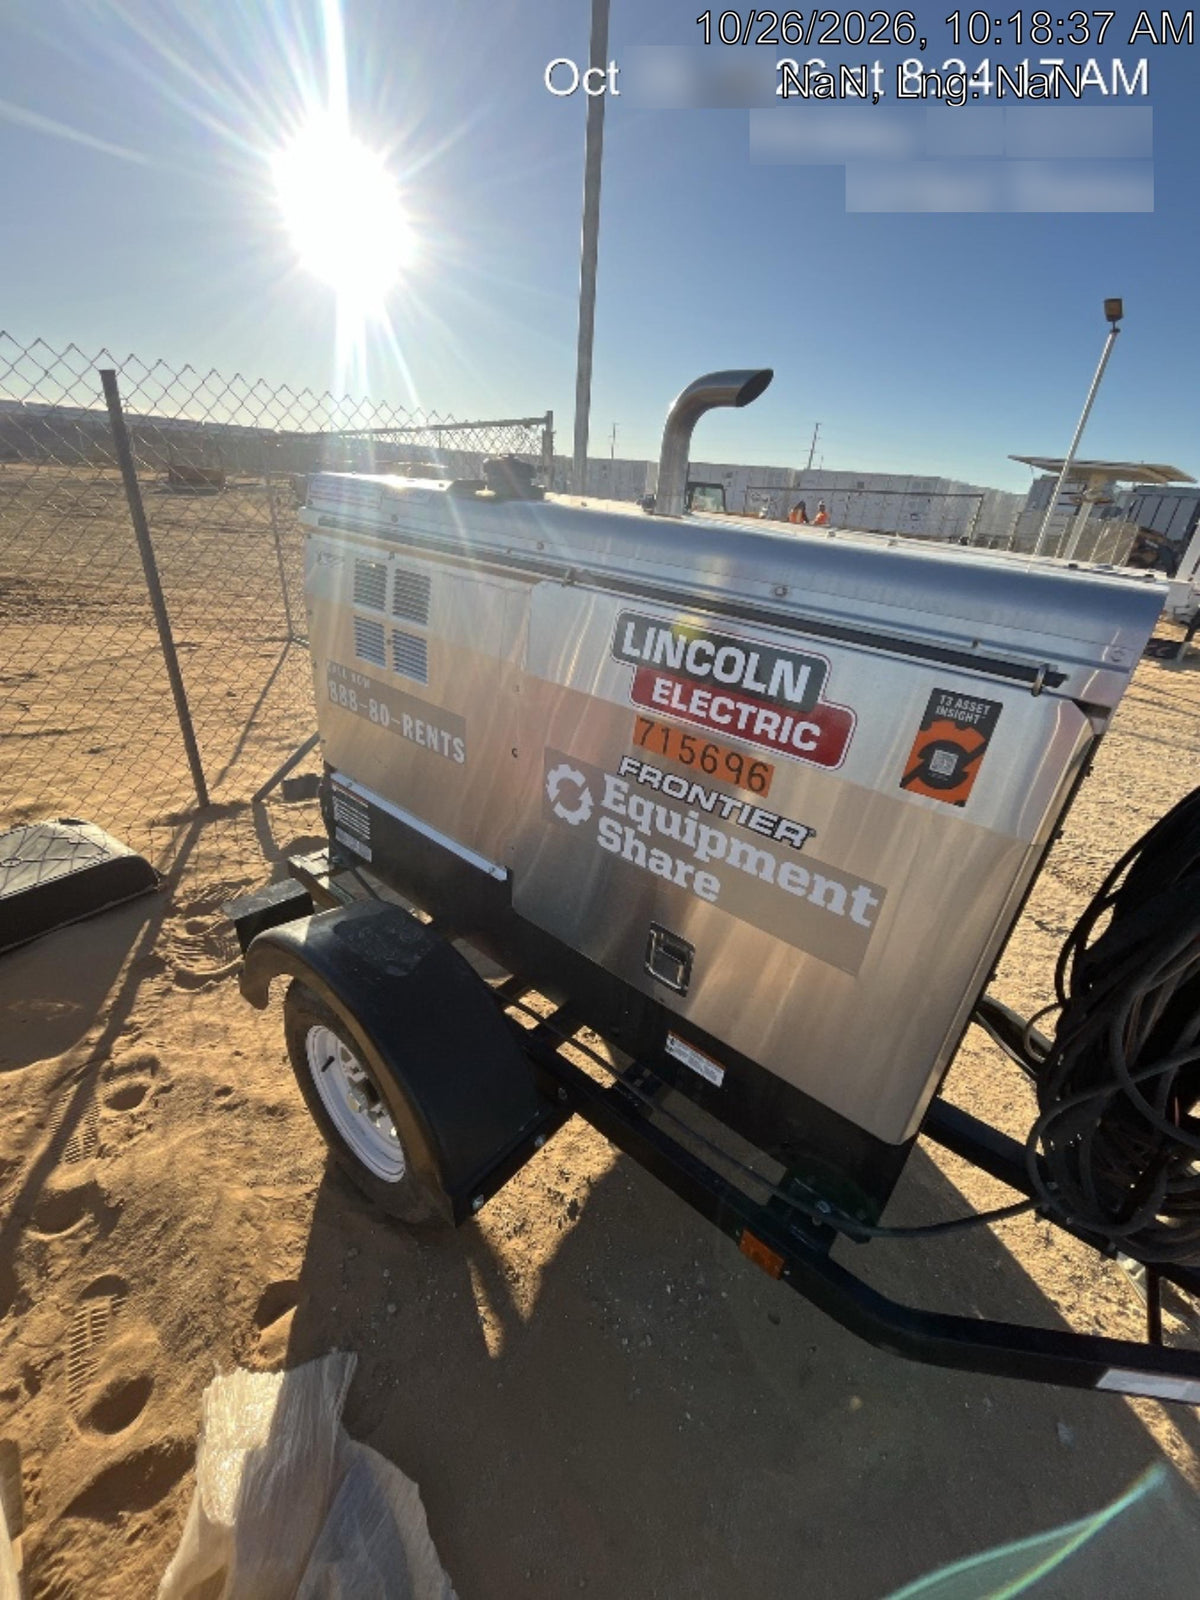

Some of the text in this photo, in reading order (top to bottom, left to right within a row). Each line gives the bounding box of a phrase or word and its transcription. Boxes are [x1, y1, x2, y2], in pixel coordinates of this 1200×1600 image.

[622, 622, 811, 702] LINCOLN
[329, 680, 465, 763] 888-80-RENTS
[652, 677, 821, 751] ELECTRIC
[935, 705, 981, 724] INSIGHT
[954, 698, 991, 715] ASSET
[638, 718, 770, 793] 715696
[617, 755, 812, 850] FRONTIER
[597, 815, 721, 902] Share
[600, 773, 879, 928] Equipment
